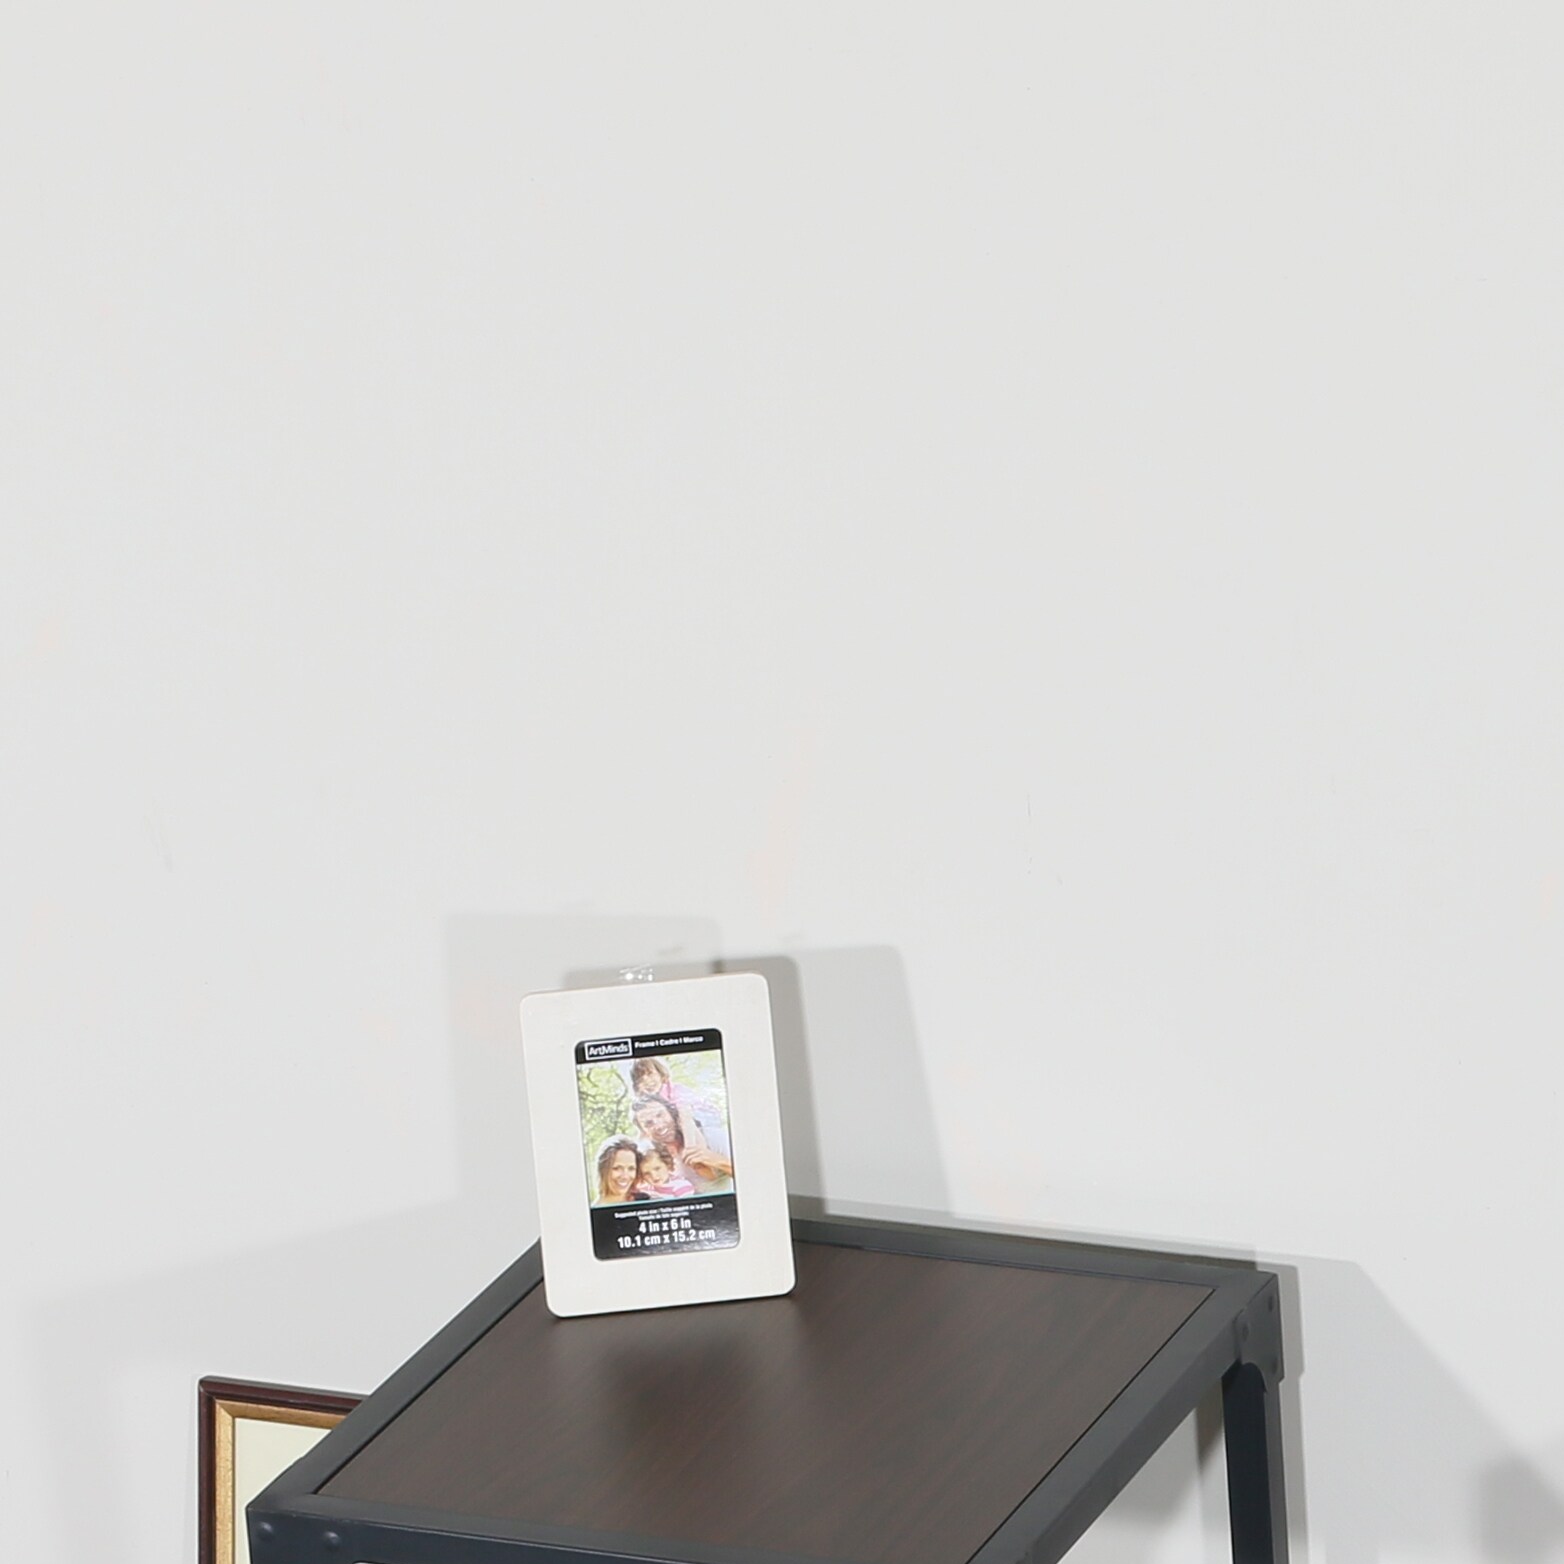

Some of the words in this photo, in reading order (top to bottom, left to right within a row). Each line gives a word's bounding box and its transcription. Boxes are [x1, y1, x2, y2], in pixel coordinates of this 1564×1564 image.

[588, 1043, 629, 1056] ArtMinds
[639, 1221, 647, 1233] 4
[649, 1220, 659, 1232] in
[670, 1218, 678, 1230] 6
[681, 1217, 692, 1229] in
[618, 1235, 642, 1249] 10.1
[644, 1234, 661, 1246] cm
[663, 1233, 670, 1244] x
[672, 1229, 696, 1243] 15.2
[699, 1228, 716, 1240] cm
